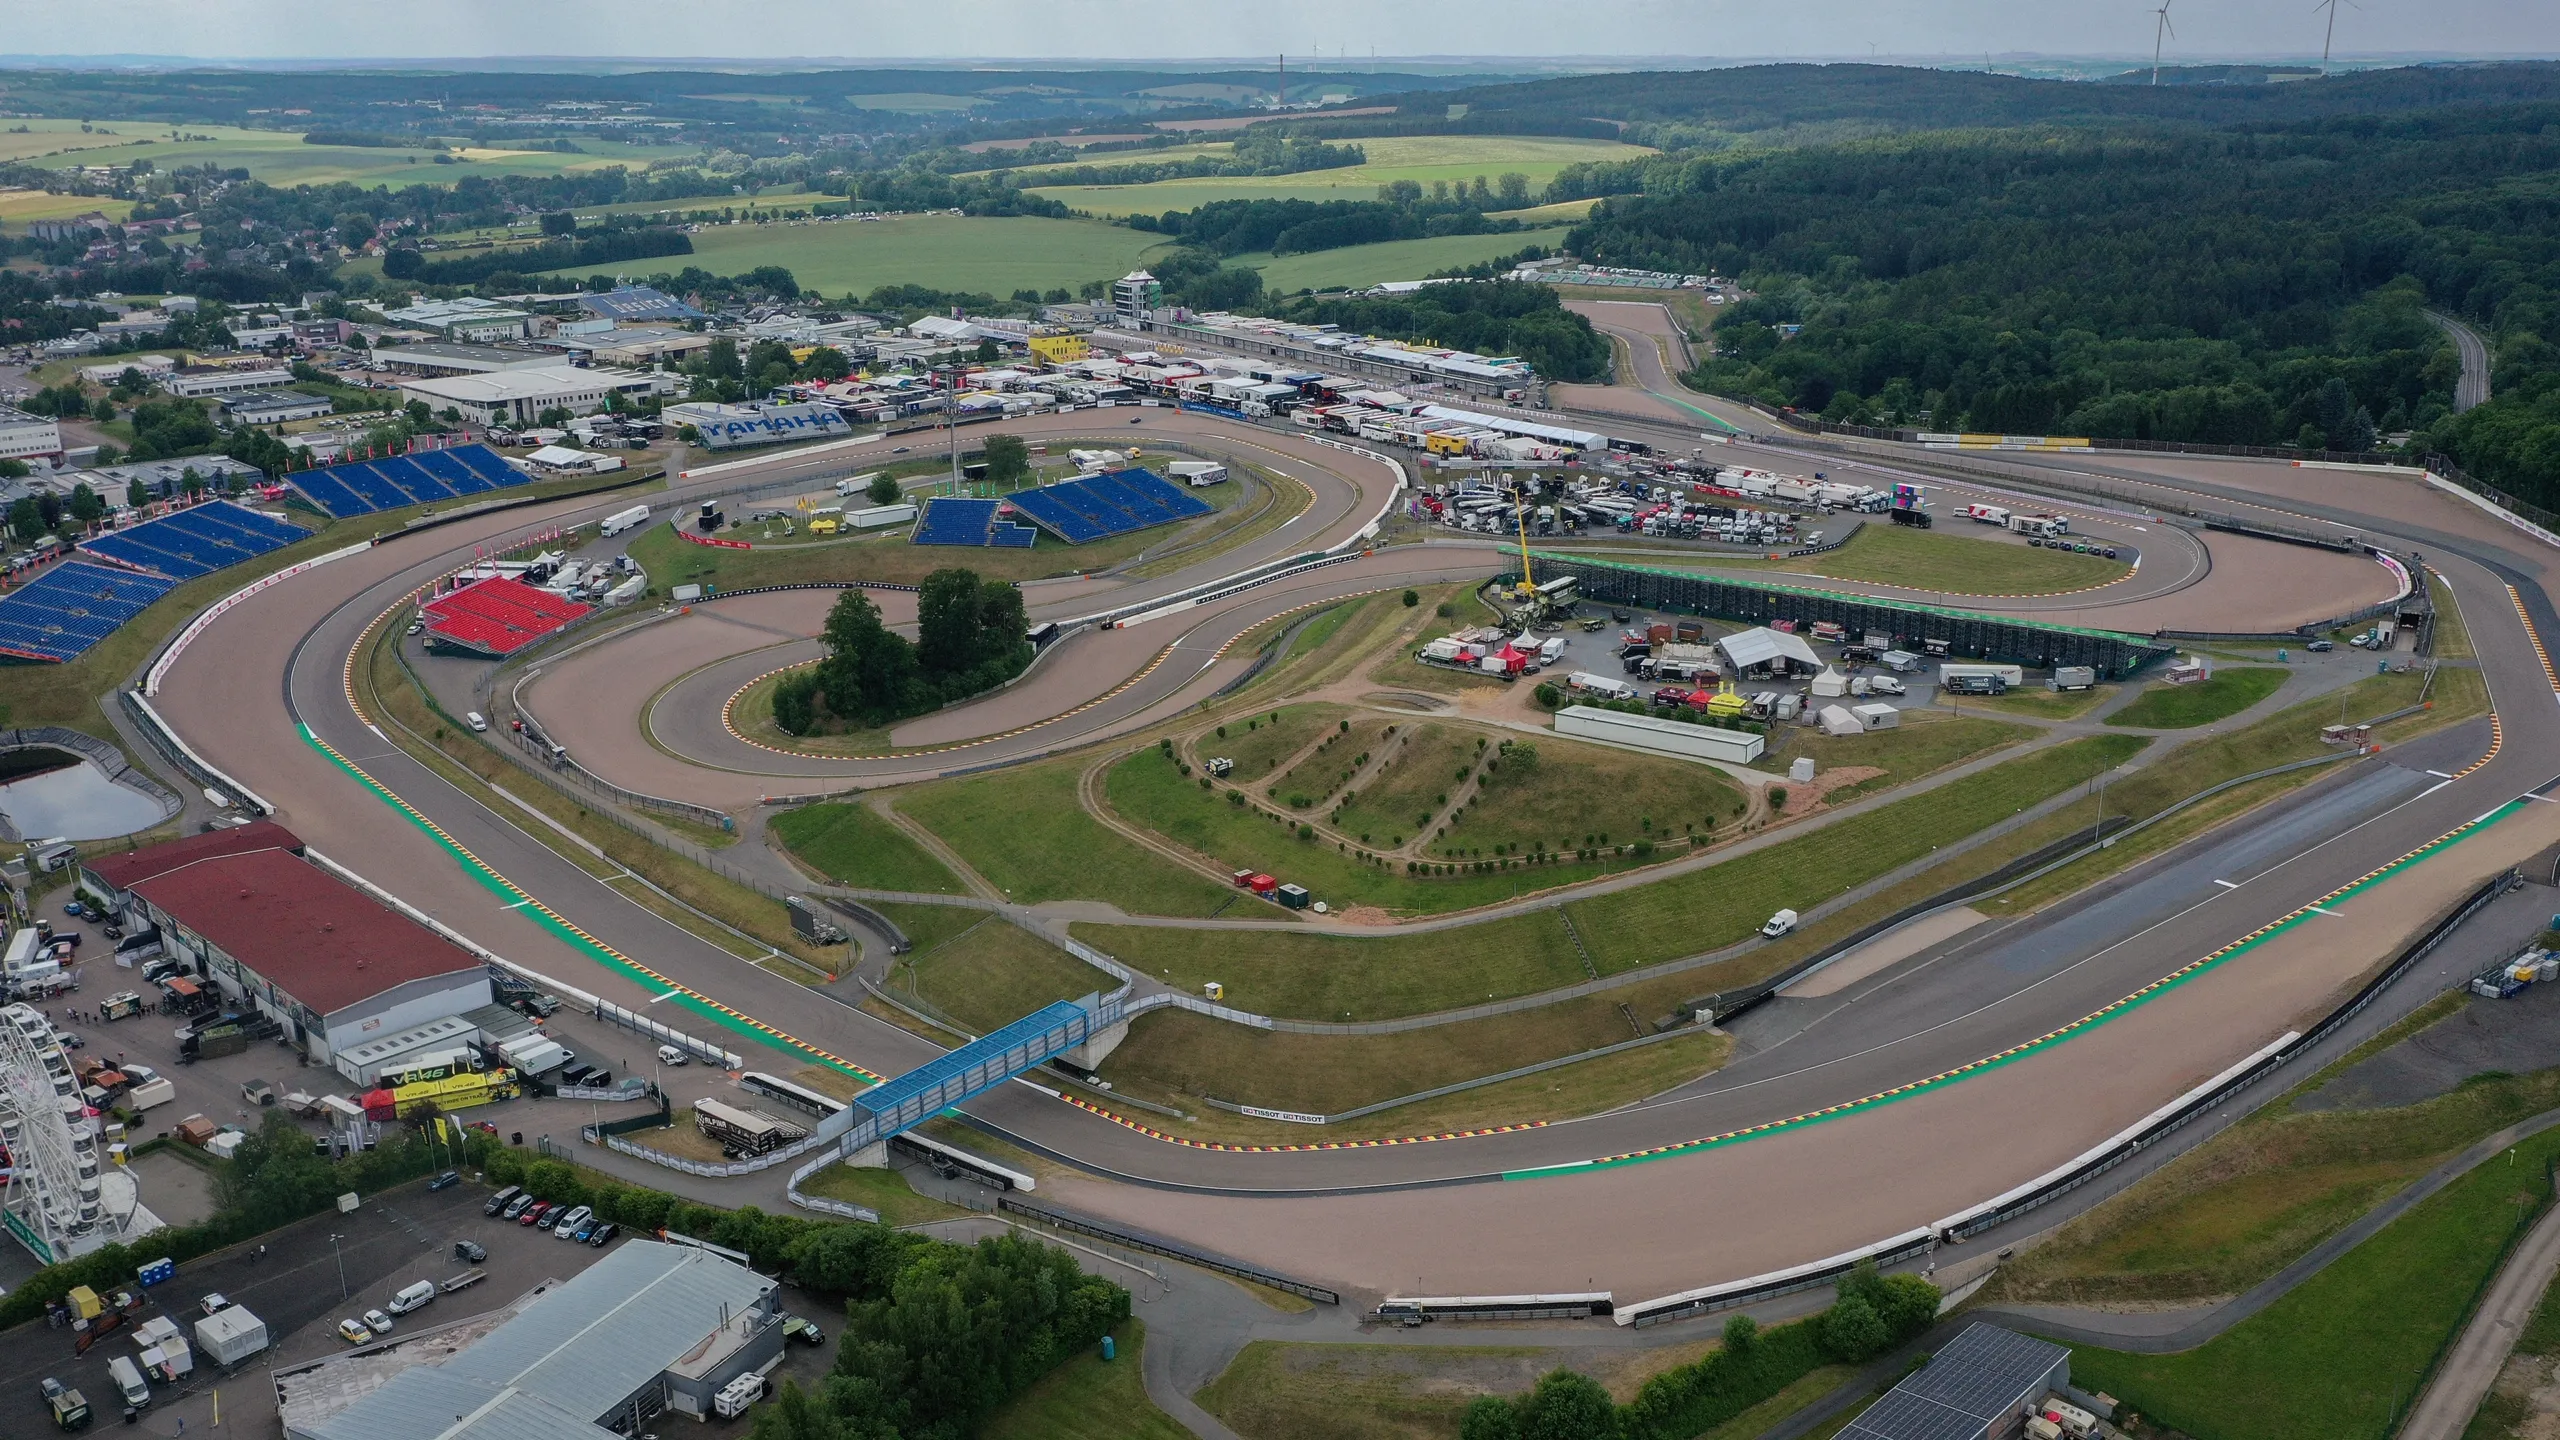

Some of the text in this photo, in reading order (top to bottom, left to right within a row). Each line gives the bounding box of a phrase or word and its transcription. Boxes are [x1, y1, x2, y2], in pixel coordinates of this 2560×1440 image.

[701, 412, 843, 436] YAMAHA
[1254, 1109, 1323, 1123] TISSOT TISSOT
